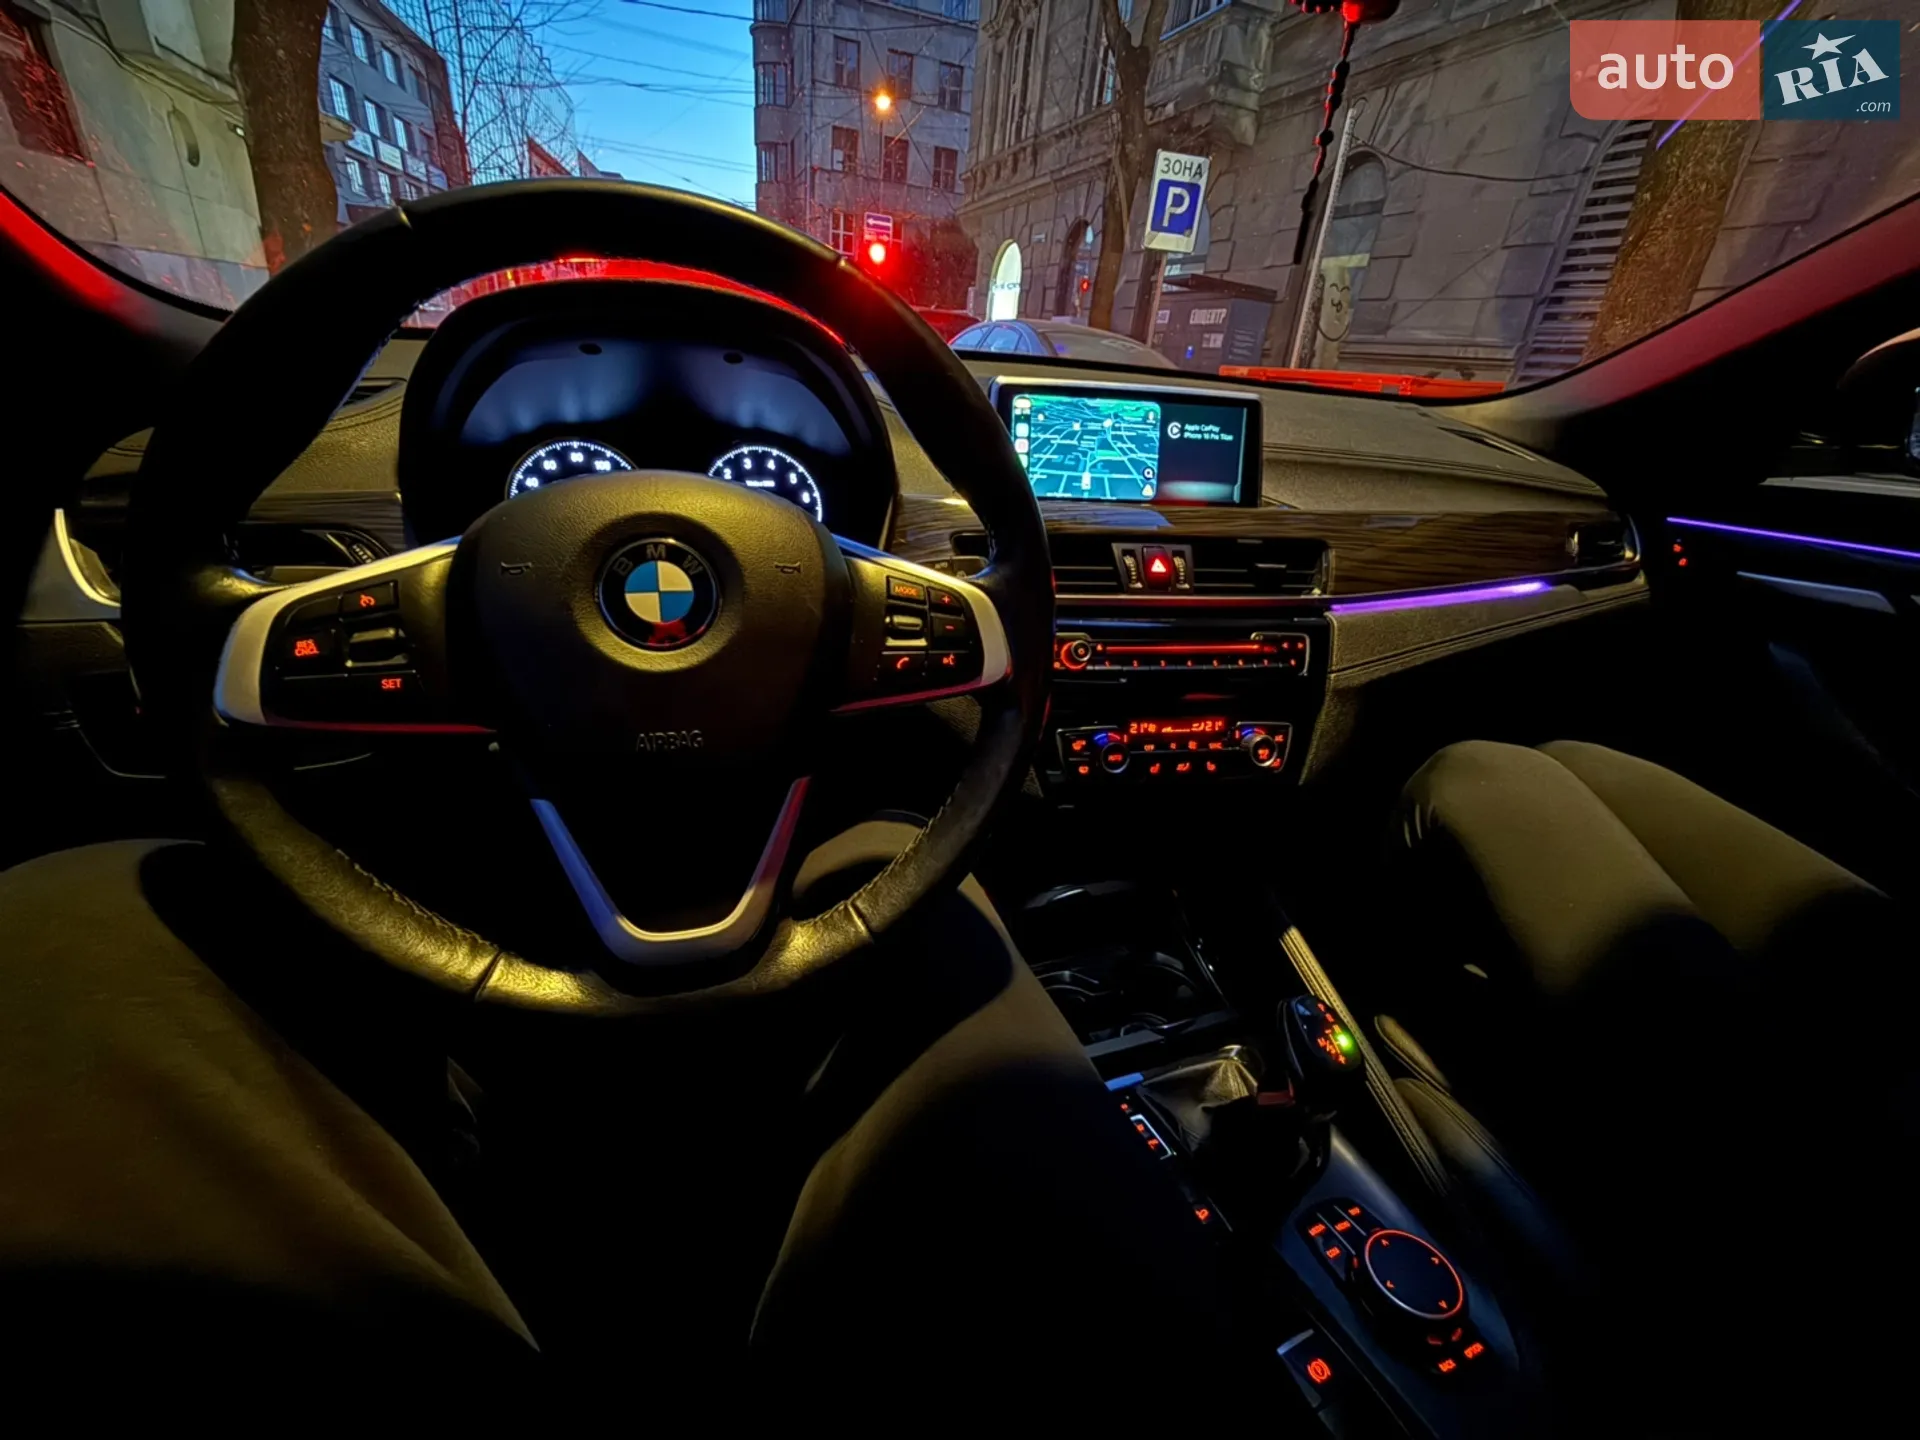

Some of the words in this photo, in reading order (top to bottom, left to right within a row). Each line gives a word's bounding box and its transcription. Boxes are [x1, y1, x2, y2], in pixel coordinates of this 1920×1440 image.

[1160, 157, 1204, 180] ЗОНА
[1162, 186, 1191, 227] P
[743, 457, 752, 470] 3
[766, 458, 776, 471] 4
[723, 467, 732, 480] 2
[612, 543, 703, 576] BMW
[894, 584, 919, 597] MODE
[382, 678, 402, 689] SET
[636, 729, 704, 752] AIRBAG
